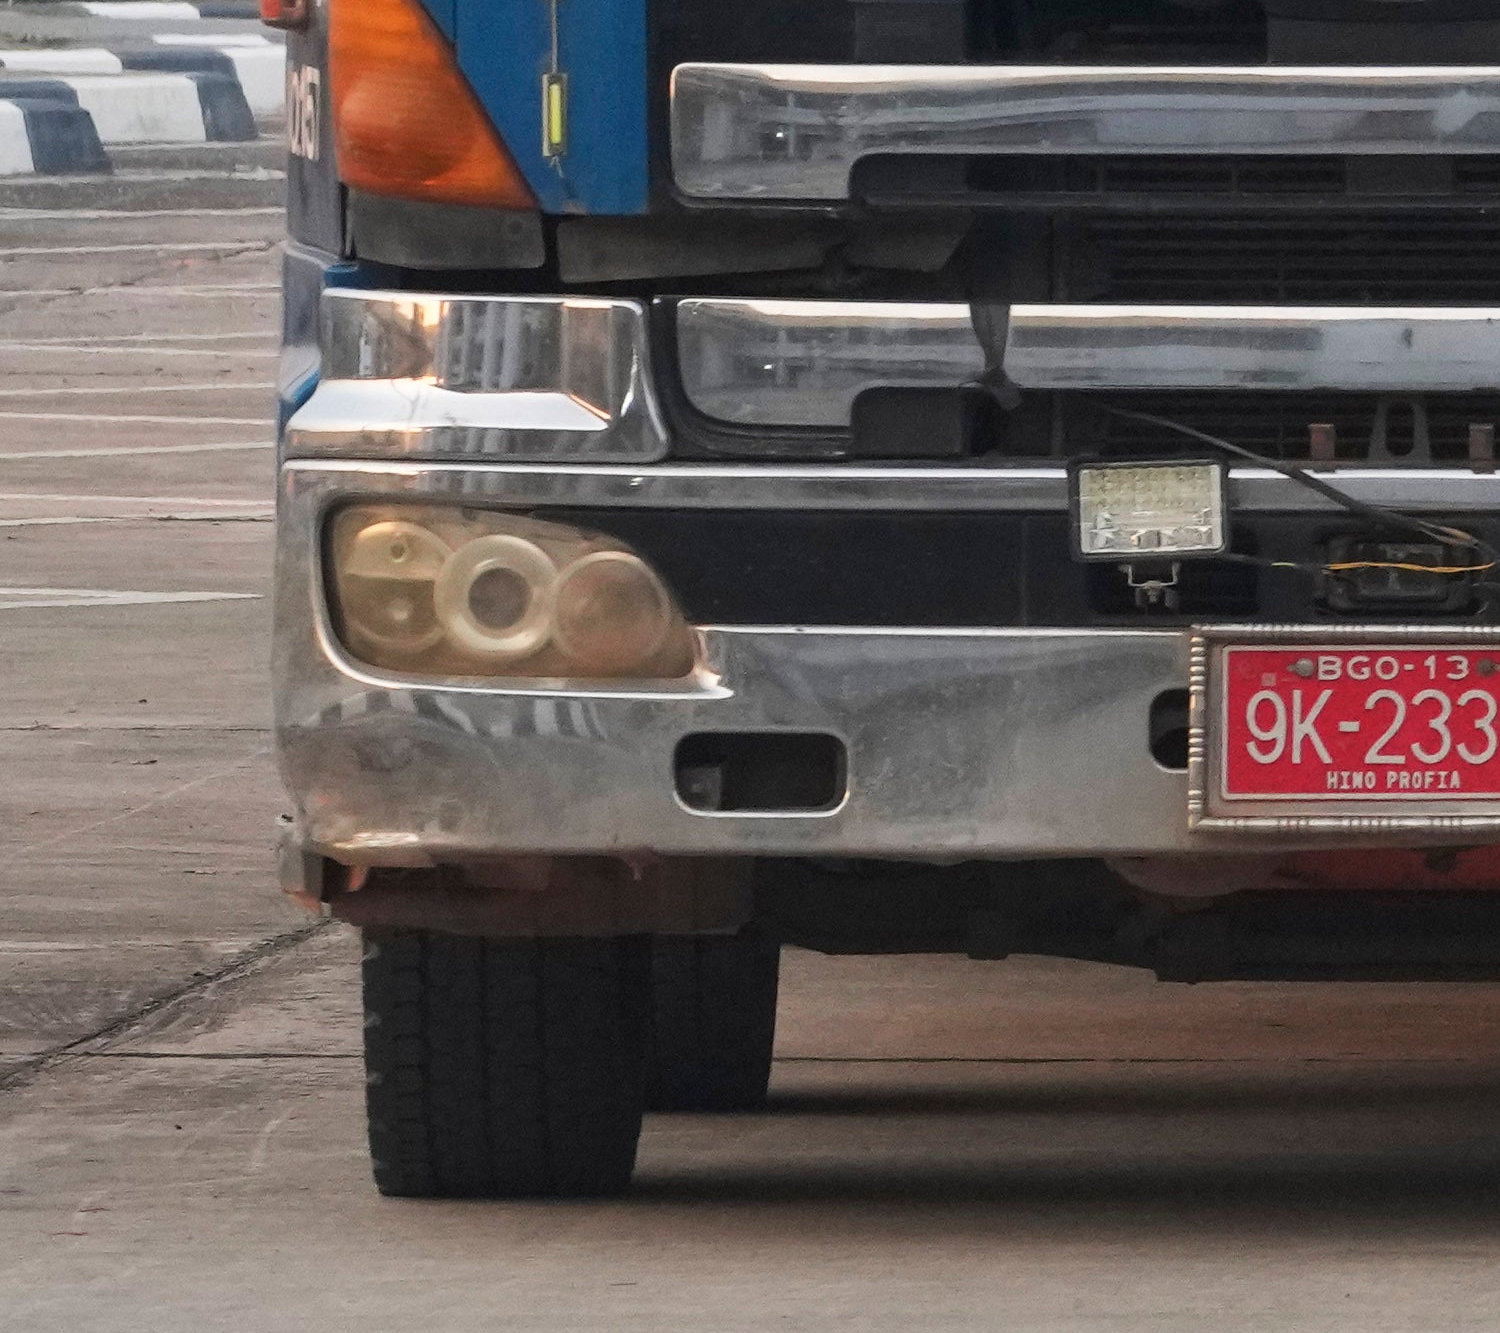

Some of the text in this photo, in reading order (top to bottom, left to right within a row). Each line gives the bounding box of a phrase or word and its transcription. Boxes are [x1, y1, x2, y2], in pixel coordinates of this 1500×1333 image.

[1317, 655, 1470, 680] BGO-13
[1326, 769, 1461, 790] HINO PROFIA
